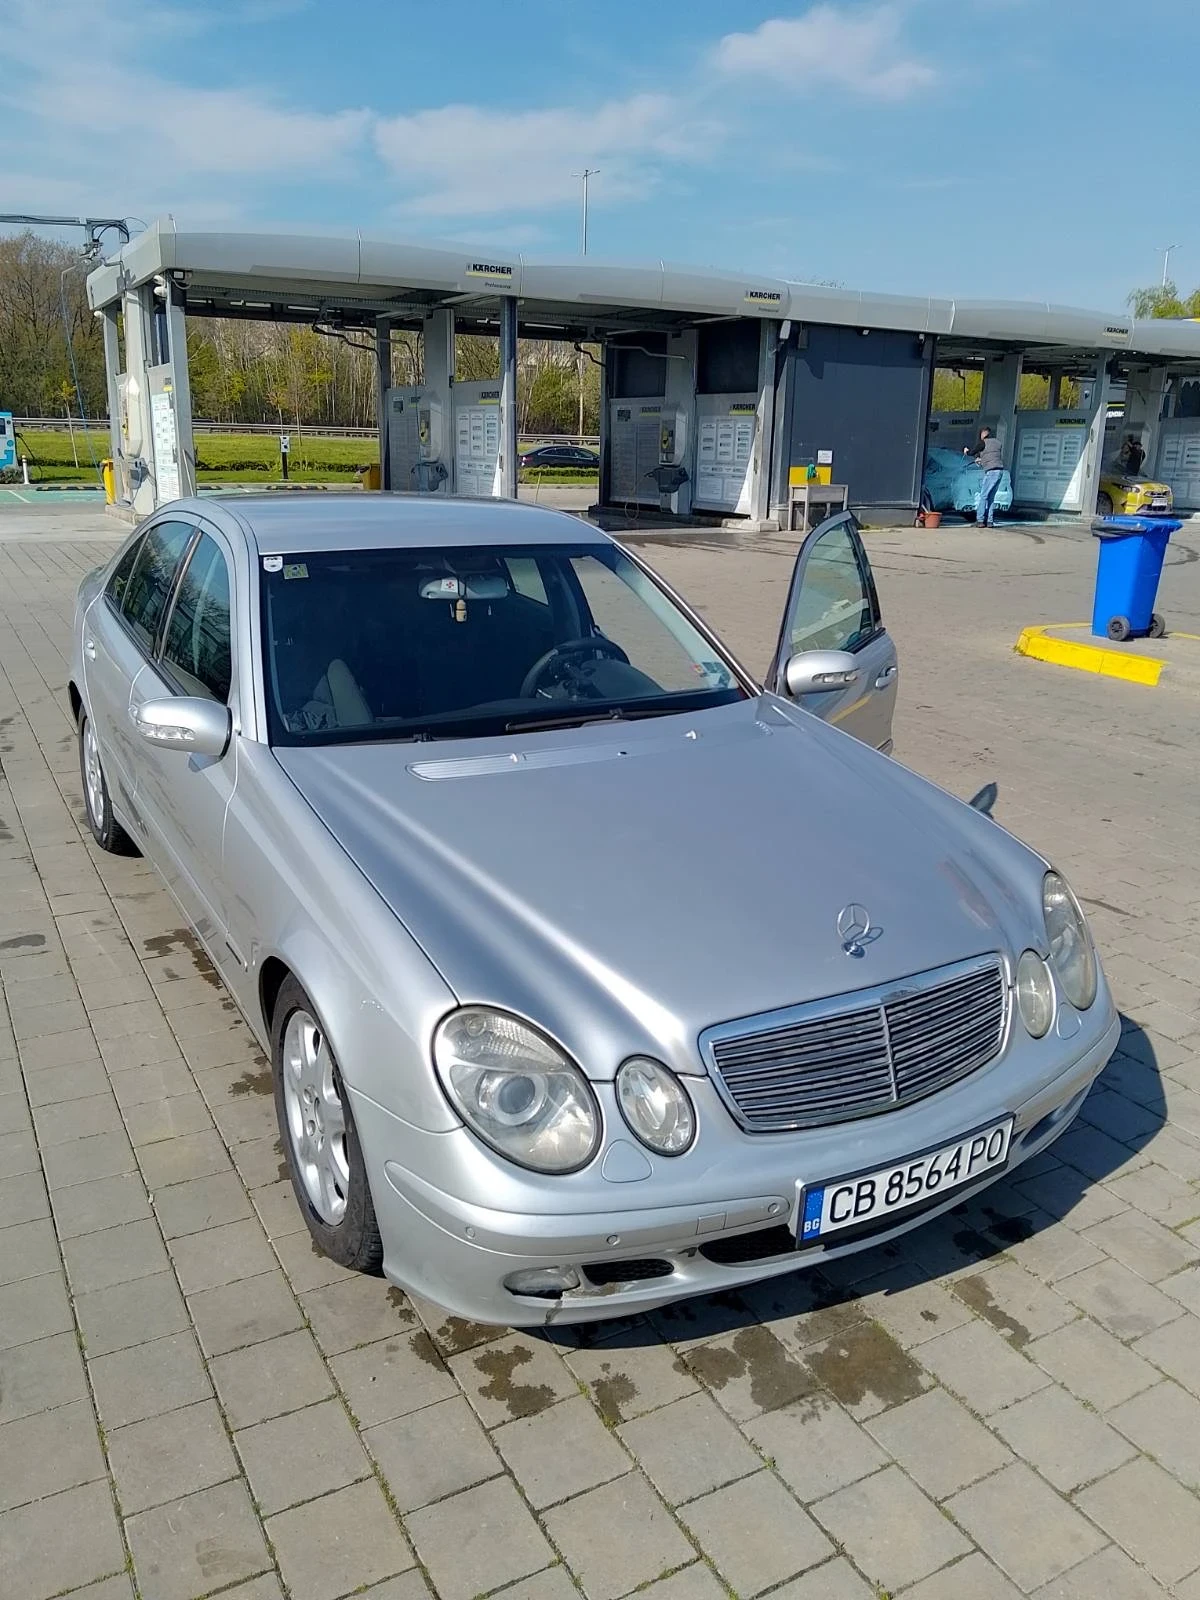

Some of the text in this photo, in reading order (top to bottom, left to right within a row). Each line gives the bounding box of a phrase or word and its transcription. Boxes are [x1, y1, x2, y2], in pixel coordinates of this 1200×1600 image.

[829, 1128, 1004, 1224] CB 8564 PO
[804, 1217, 820, 1233] BG
